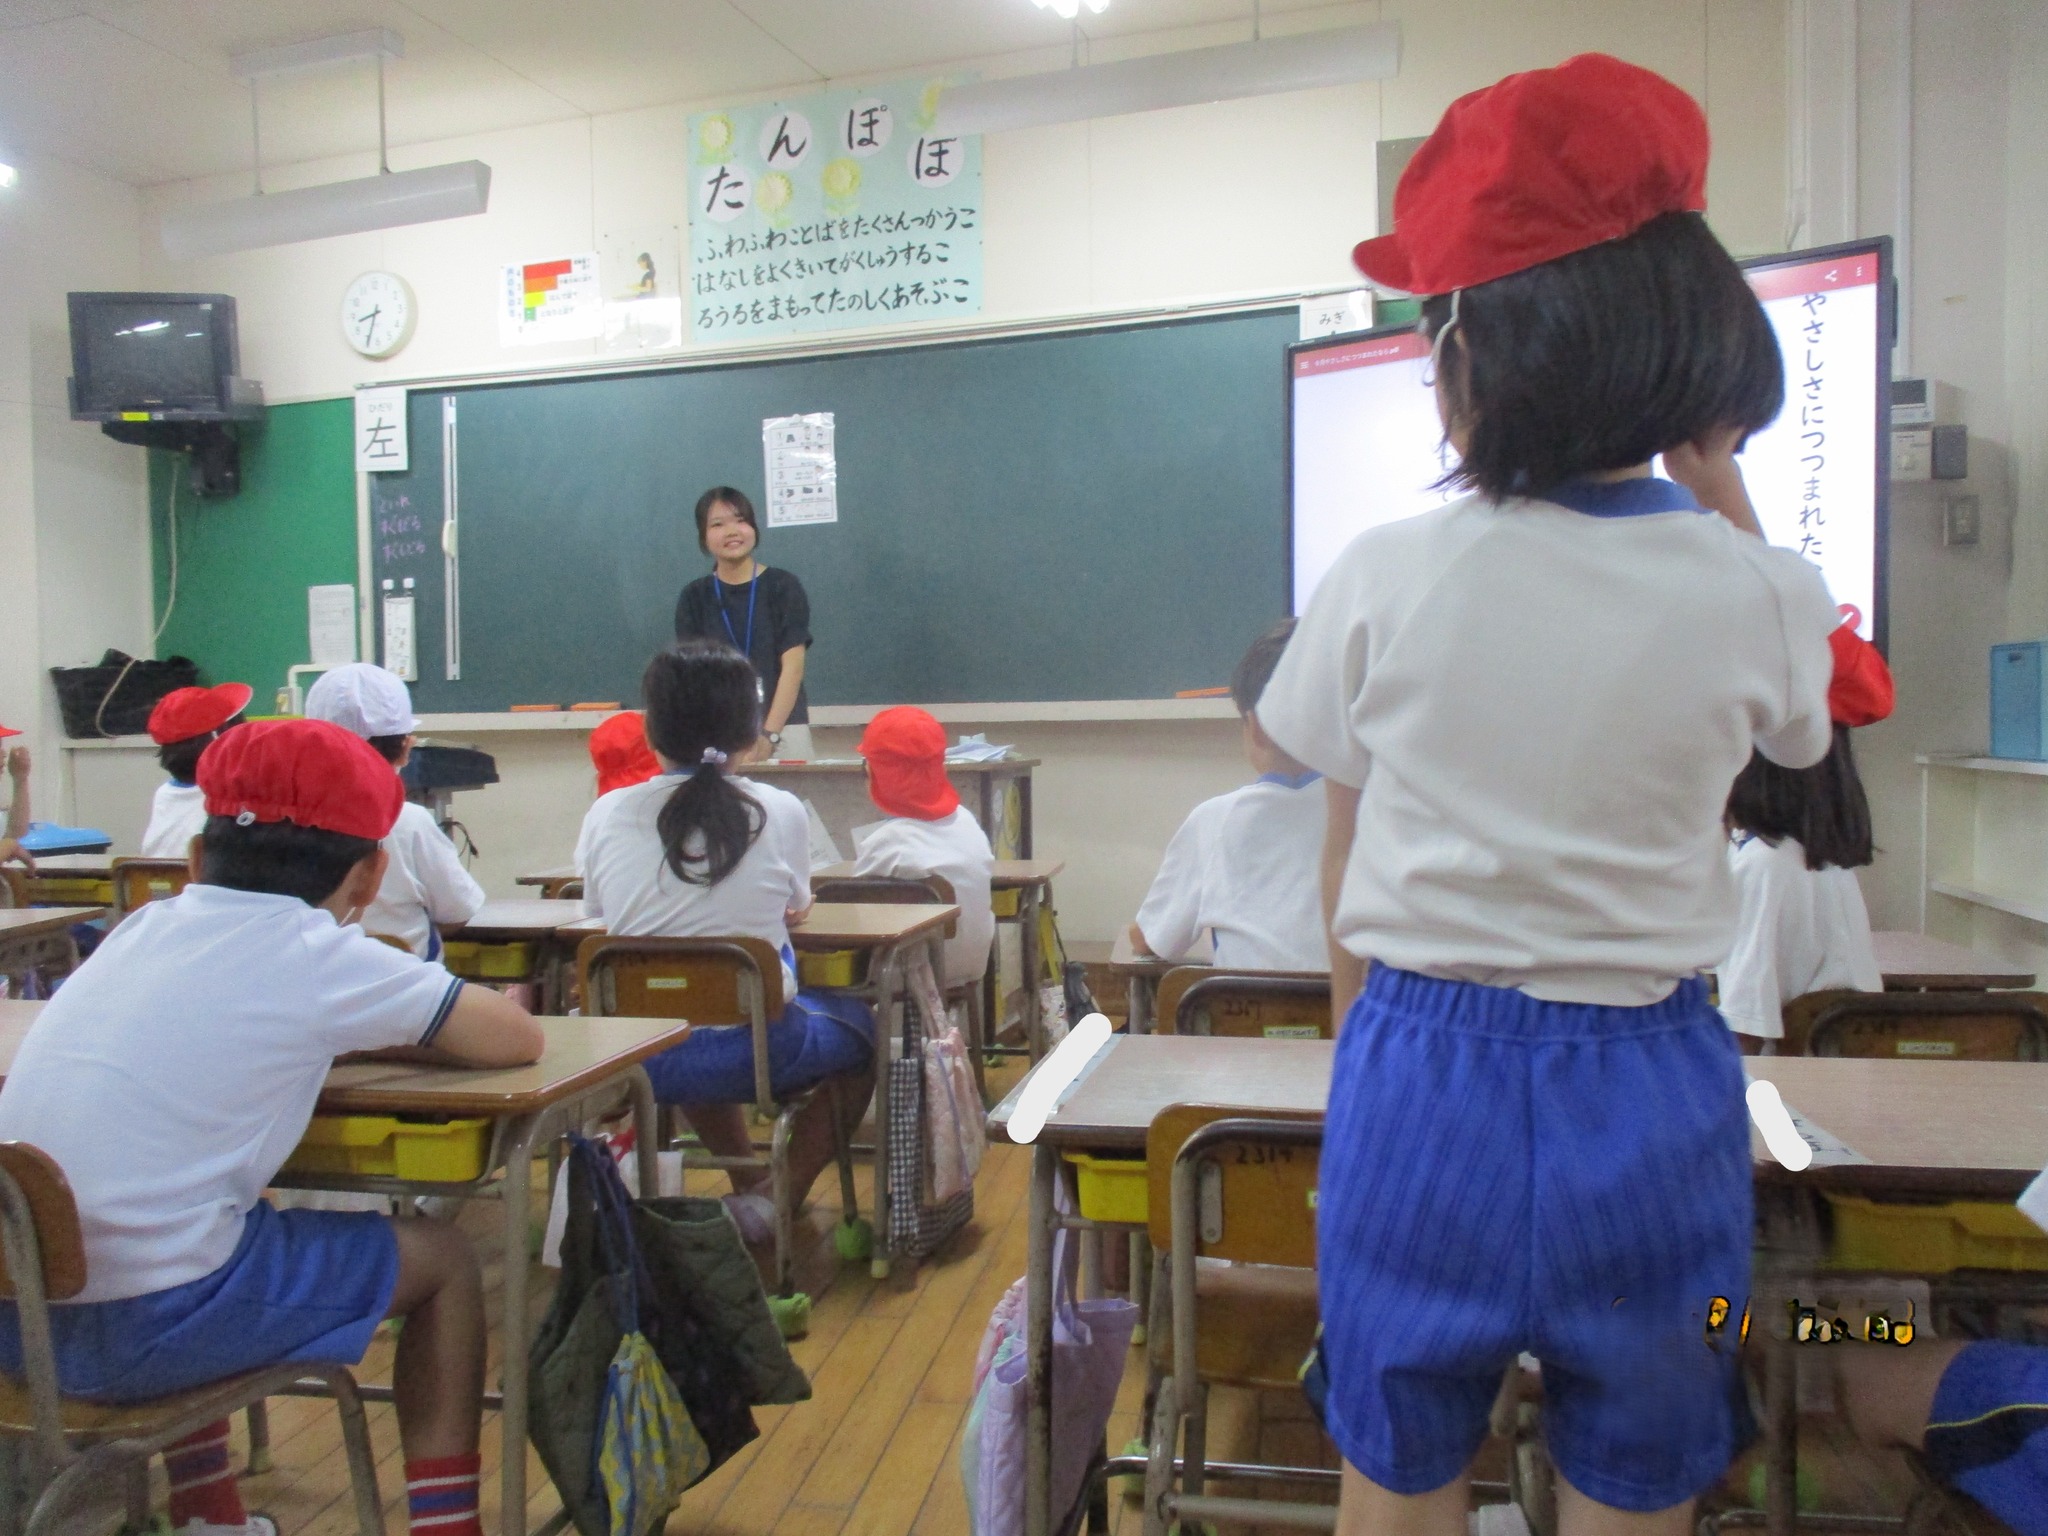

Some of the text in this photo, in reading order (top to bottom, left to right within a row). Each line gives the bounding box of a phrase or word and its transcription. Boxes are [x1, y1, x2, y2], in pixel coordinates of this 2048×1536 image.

[697, 207, 976, 263] ふわふわことばをたくさんつかうこ
[1319, 311, 1346, 325] みぎ
[363, 417, 399, 459] 左
[1799, 293, 1827, 572] やさしさにつつまれた
